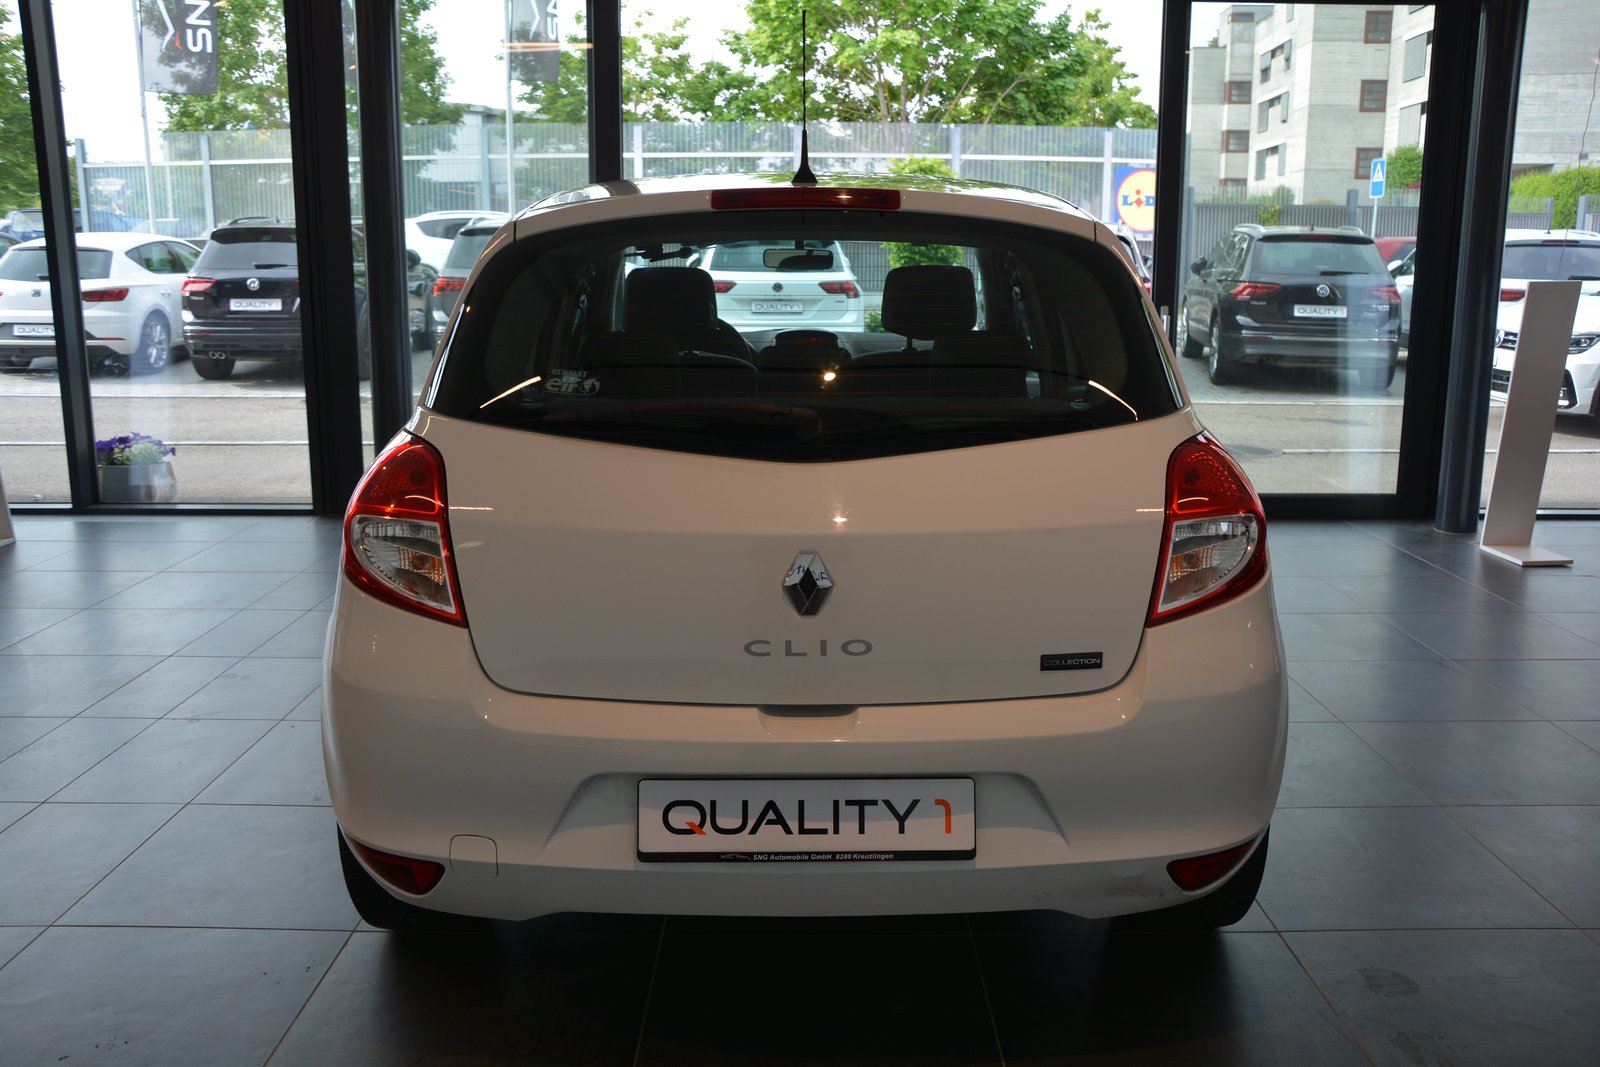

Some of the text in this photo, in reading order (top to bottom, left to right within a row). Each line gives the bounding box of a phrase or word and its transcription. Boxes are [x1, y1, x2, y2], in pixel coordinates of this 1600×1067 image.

[1297, 307, 1338, 316] QUALITY
[551, 368, 588, 377] RENAULT
[743, 639, 873, 657] CLIO
[1043, 658, 1101, 666] COLLECTION
[661, 798, 952, 836] QUALITY 1
[811, 853, 832, 861] GmbH
[853, 853, 894, 861] Kreuzlingen
